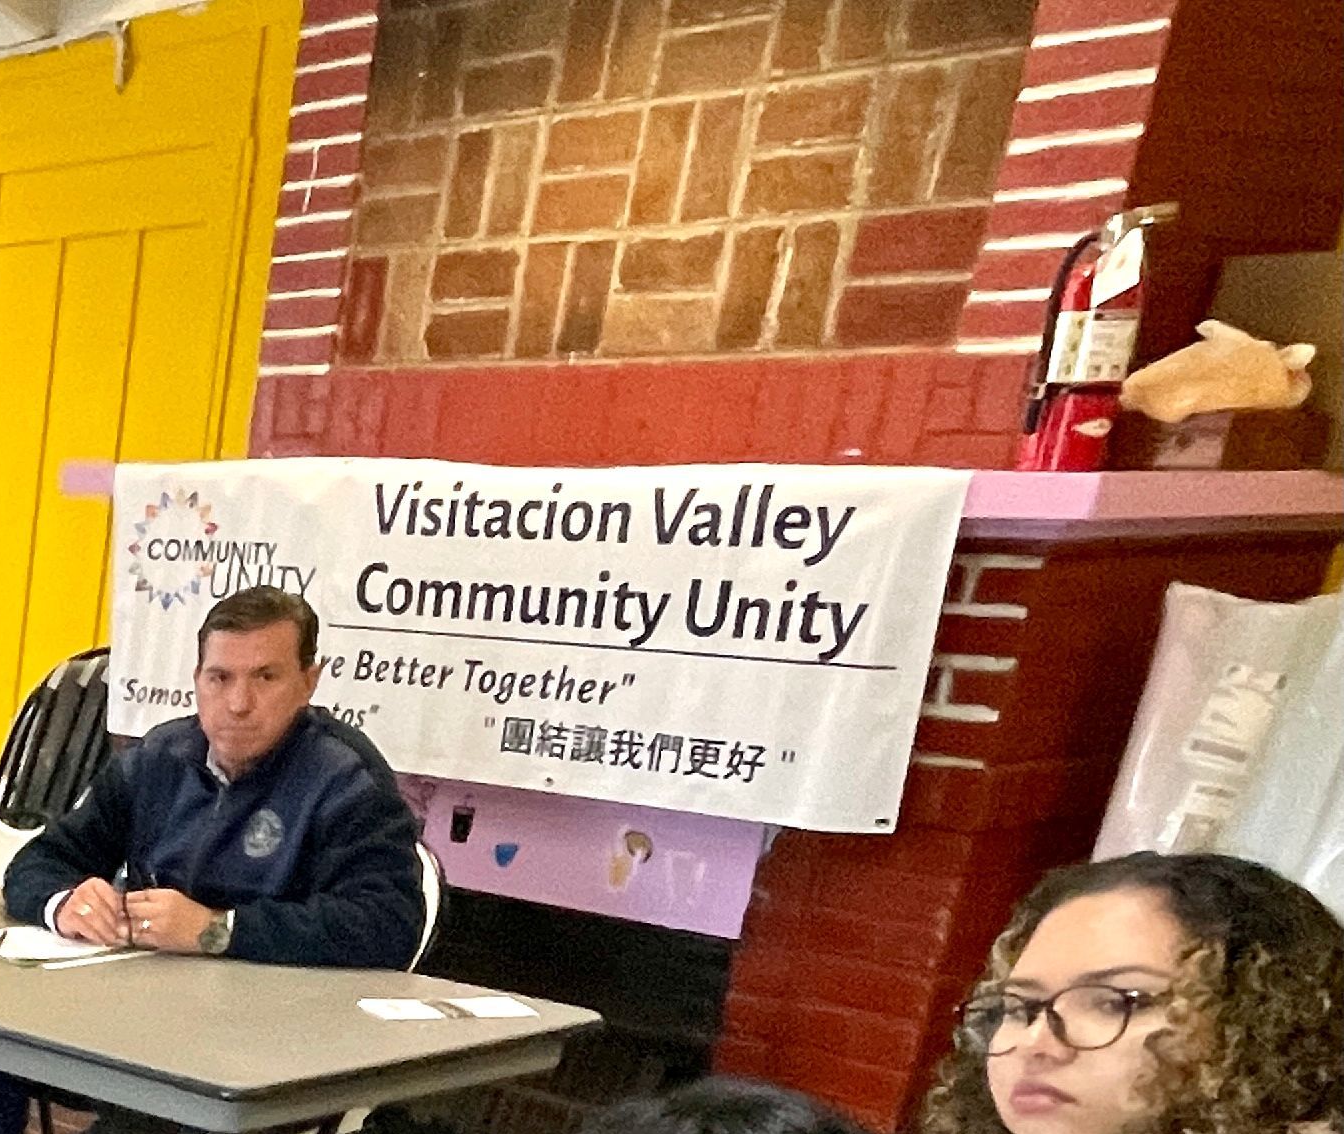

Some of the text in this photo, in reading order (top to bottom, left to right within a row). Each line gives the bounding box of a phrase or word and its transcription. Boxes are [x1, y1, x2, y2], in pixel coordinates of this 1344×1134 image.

[147, 537, 278, 566] COMMUNITY
[374, 480, 857, 567] Visitacion Valley
[210, 559, 317, 599] UNITY
[355, 561, 870, 661] Community Unity
[353, 649, 454, 691] Better
[463, 658, 636, 705] Together"
